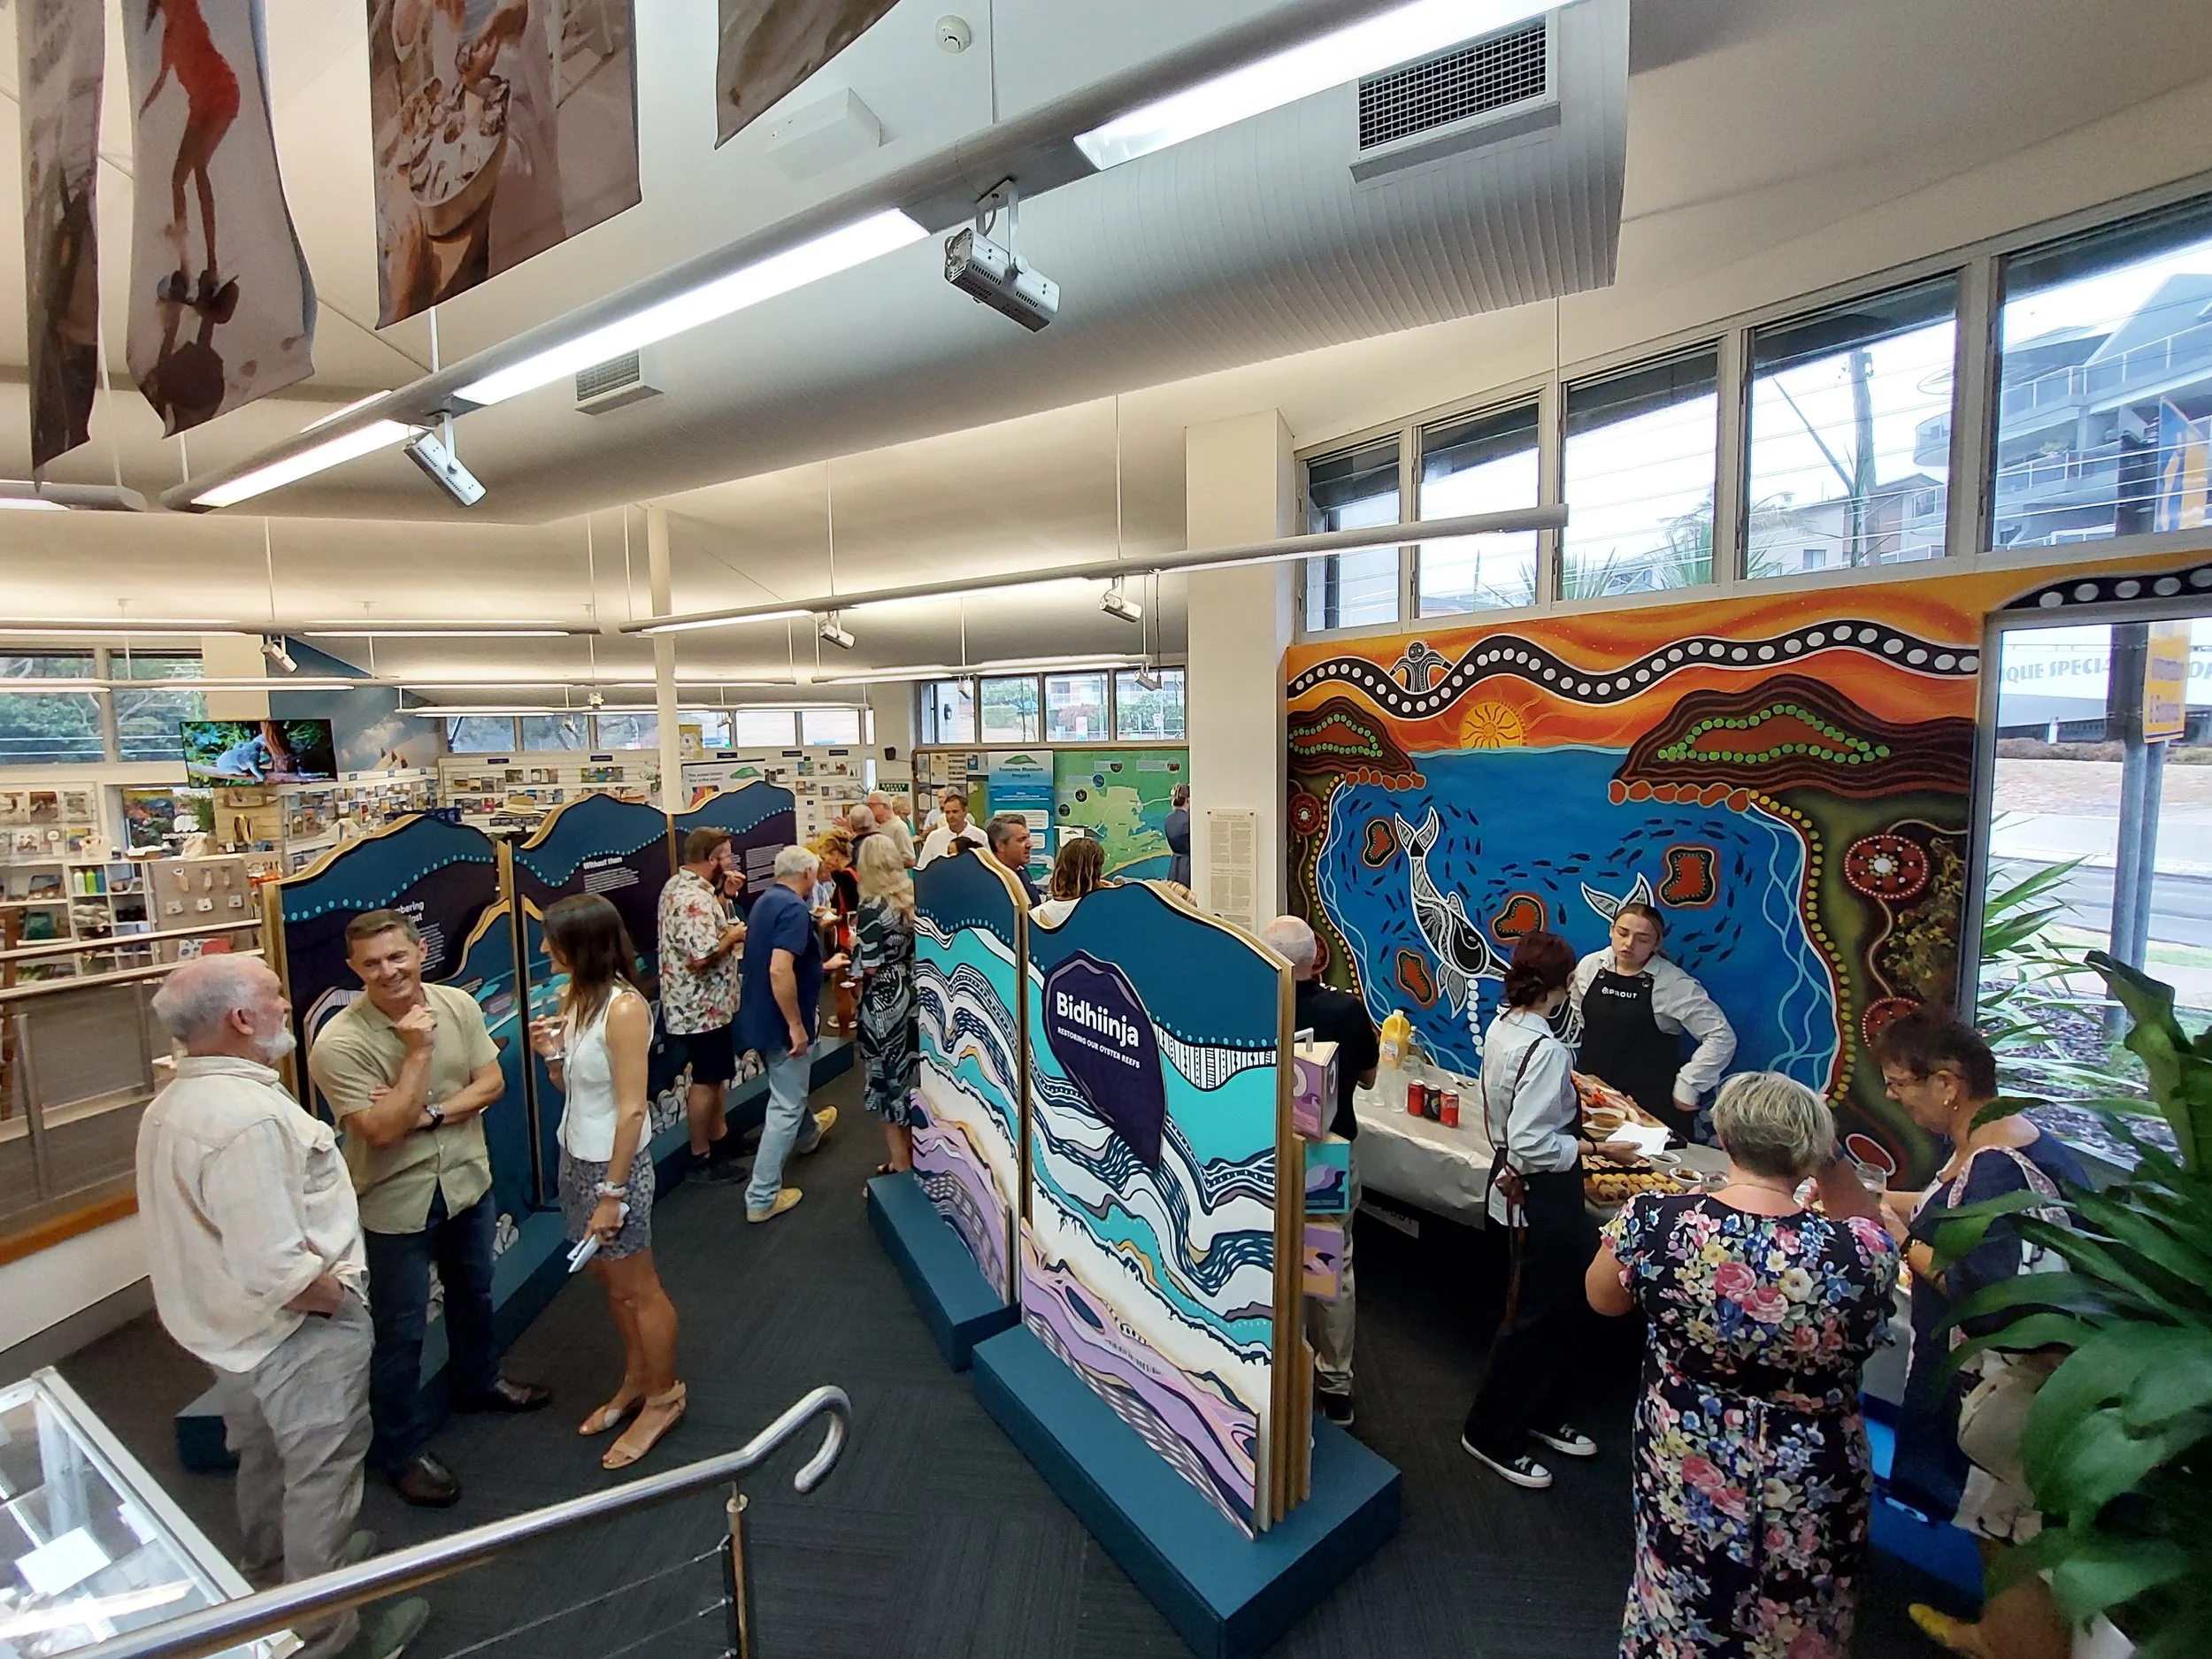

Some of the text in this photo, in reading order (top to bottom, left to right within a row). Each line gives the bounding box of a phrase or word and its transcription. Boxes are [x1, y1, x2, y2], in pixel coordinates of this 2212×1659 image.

[1056, 991, 1139, 1048] Bidhiinja
[1057, 1026, 1141, 1069] RESTORING OUR OYSTER REEFS
